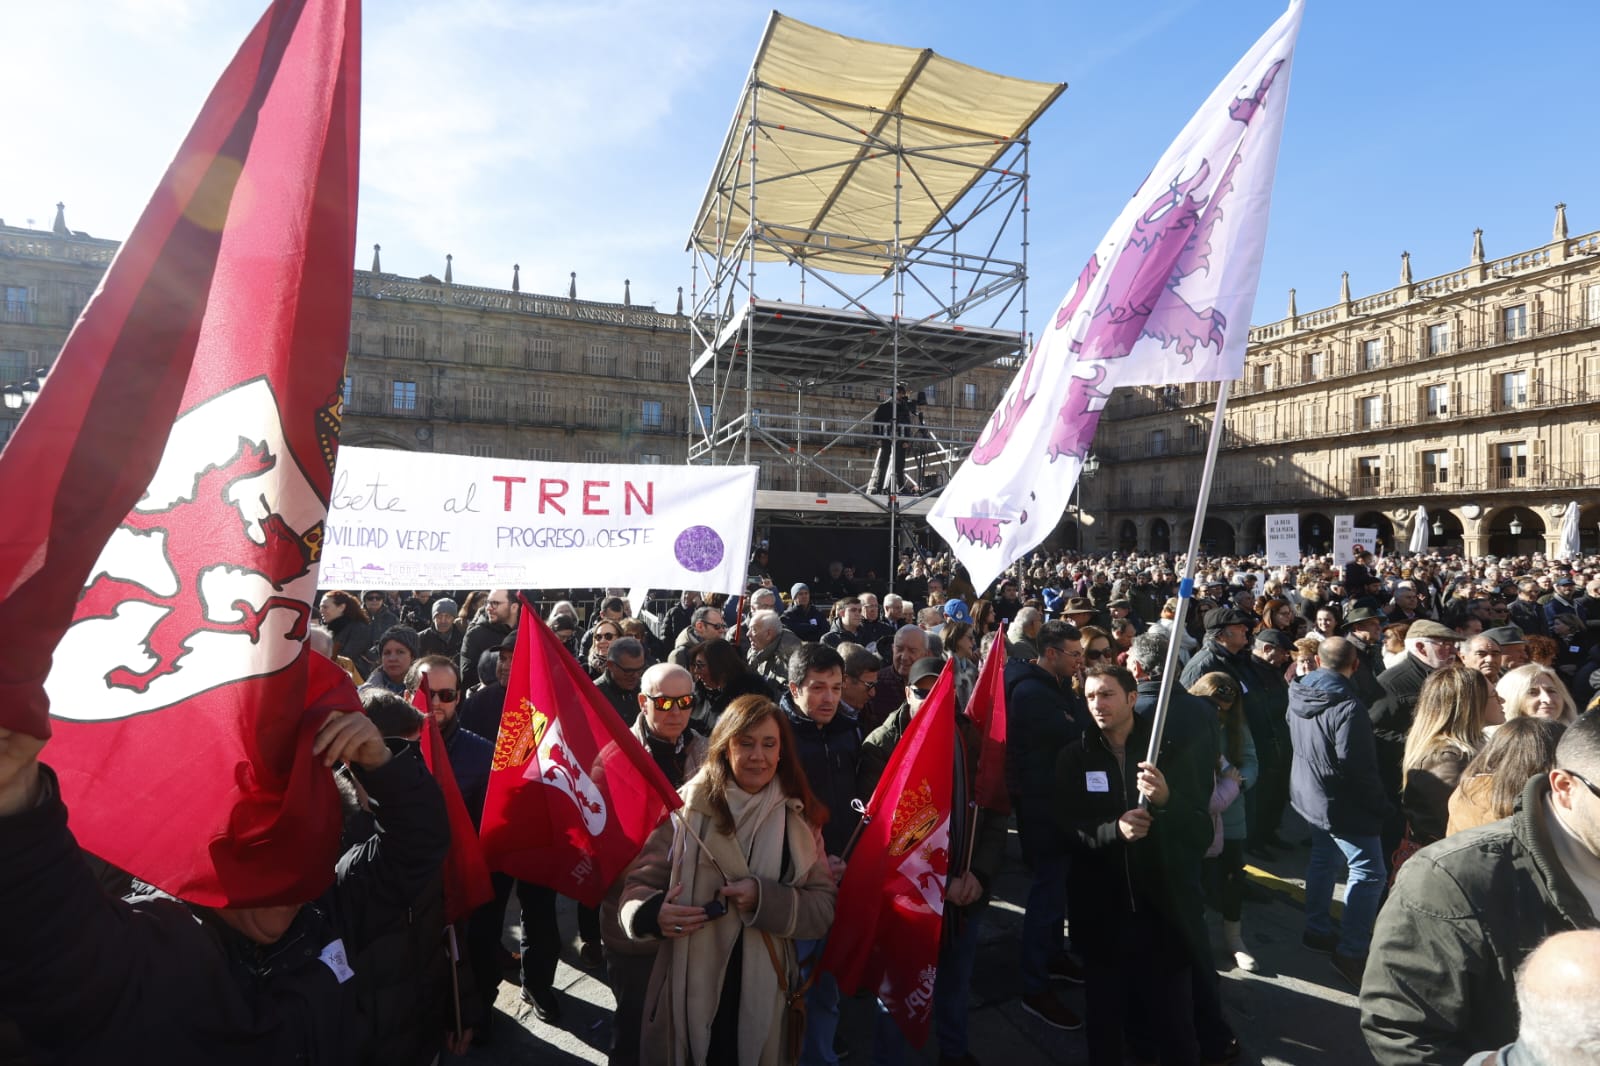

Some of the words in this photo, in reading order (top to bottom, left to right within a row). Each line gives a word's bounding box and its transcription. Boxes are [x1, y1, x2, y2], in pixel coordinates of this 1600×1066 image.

[332, 469, 407, 512] bete
[443, 482, 480, 513] al
[492, 475, 654, 516] TREN
[323, 525, 389, 549] OVILIDAD
[396, 529, 451, 552] VERDE
[497, 526, 585, 549] PROGRESO
[597, 527, 655, 548] OESTE
